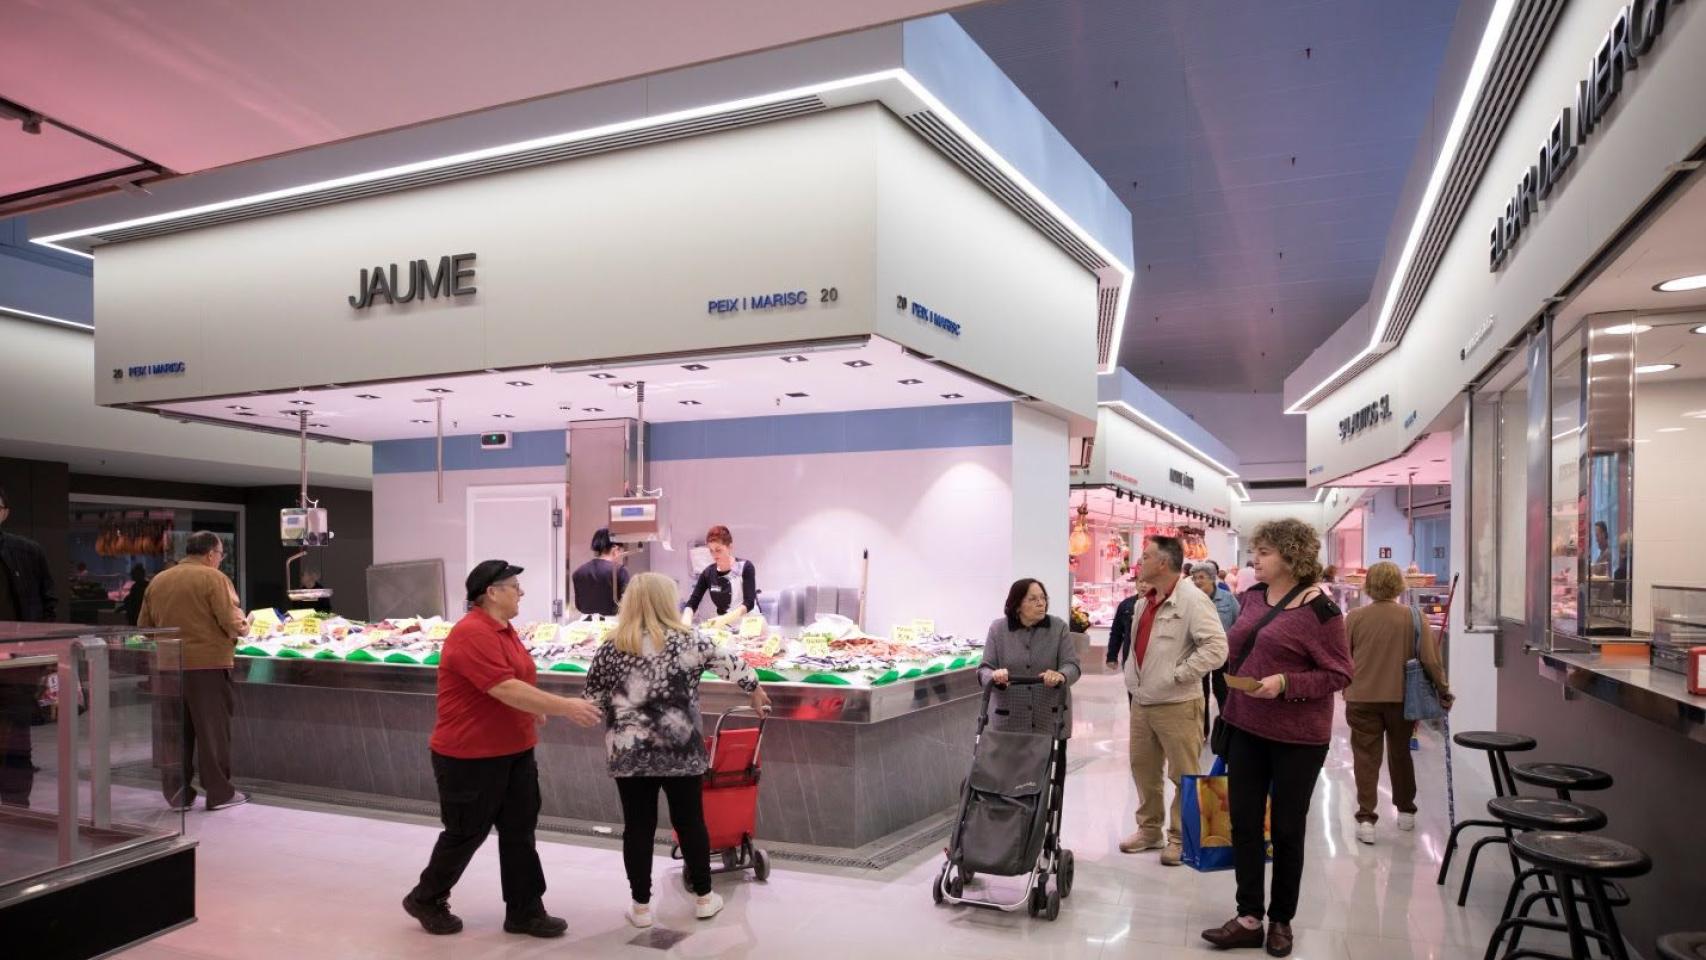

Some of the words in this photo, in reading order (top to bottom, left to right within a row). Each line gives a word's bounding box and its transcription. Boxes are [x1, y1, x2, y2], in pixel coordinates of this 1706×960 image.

[1489, 216, 1509, 274] EL
[1503, 165, 1539, 251] BAR
[1536, 107, 1579, 202] DEL
[1575, 0, 1686, 146] MERC
[348, 252, 478, 310] JAUME
[707, 298, 739, 314] PEIX
[743, 298, 747, 311] I
[751, 290, 808, 310] MARISC
[820, 287, 839, 303] 20
[896, 295, 908, 310] 20
[112, 368, 124, 379] 20
[152, 361, 186, 375] MARISC
